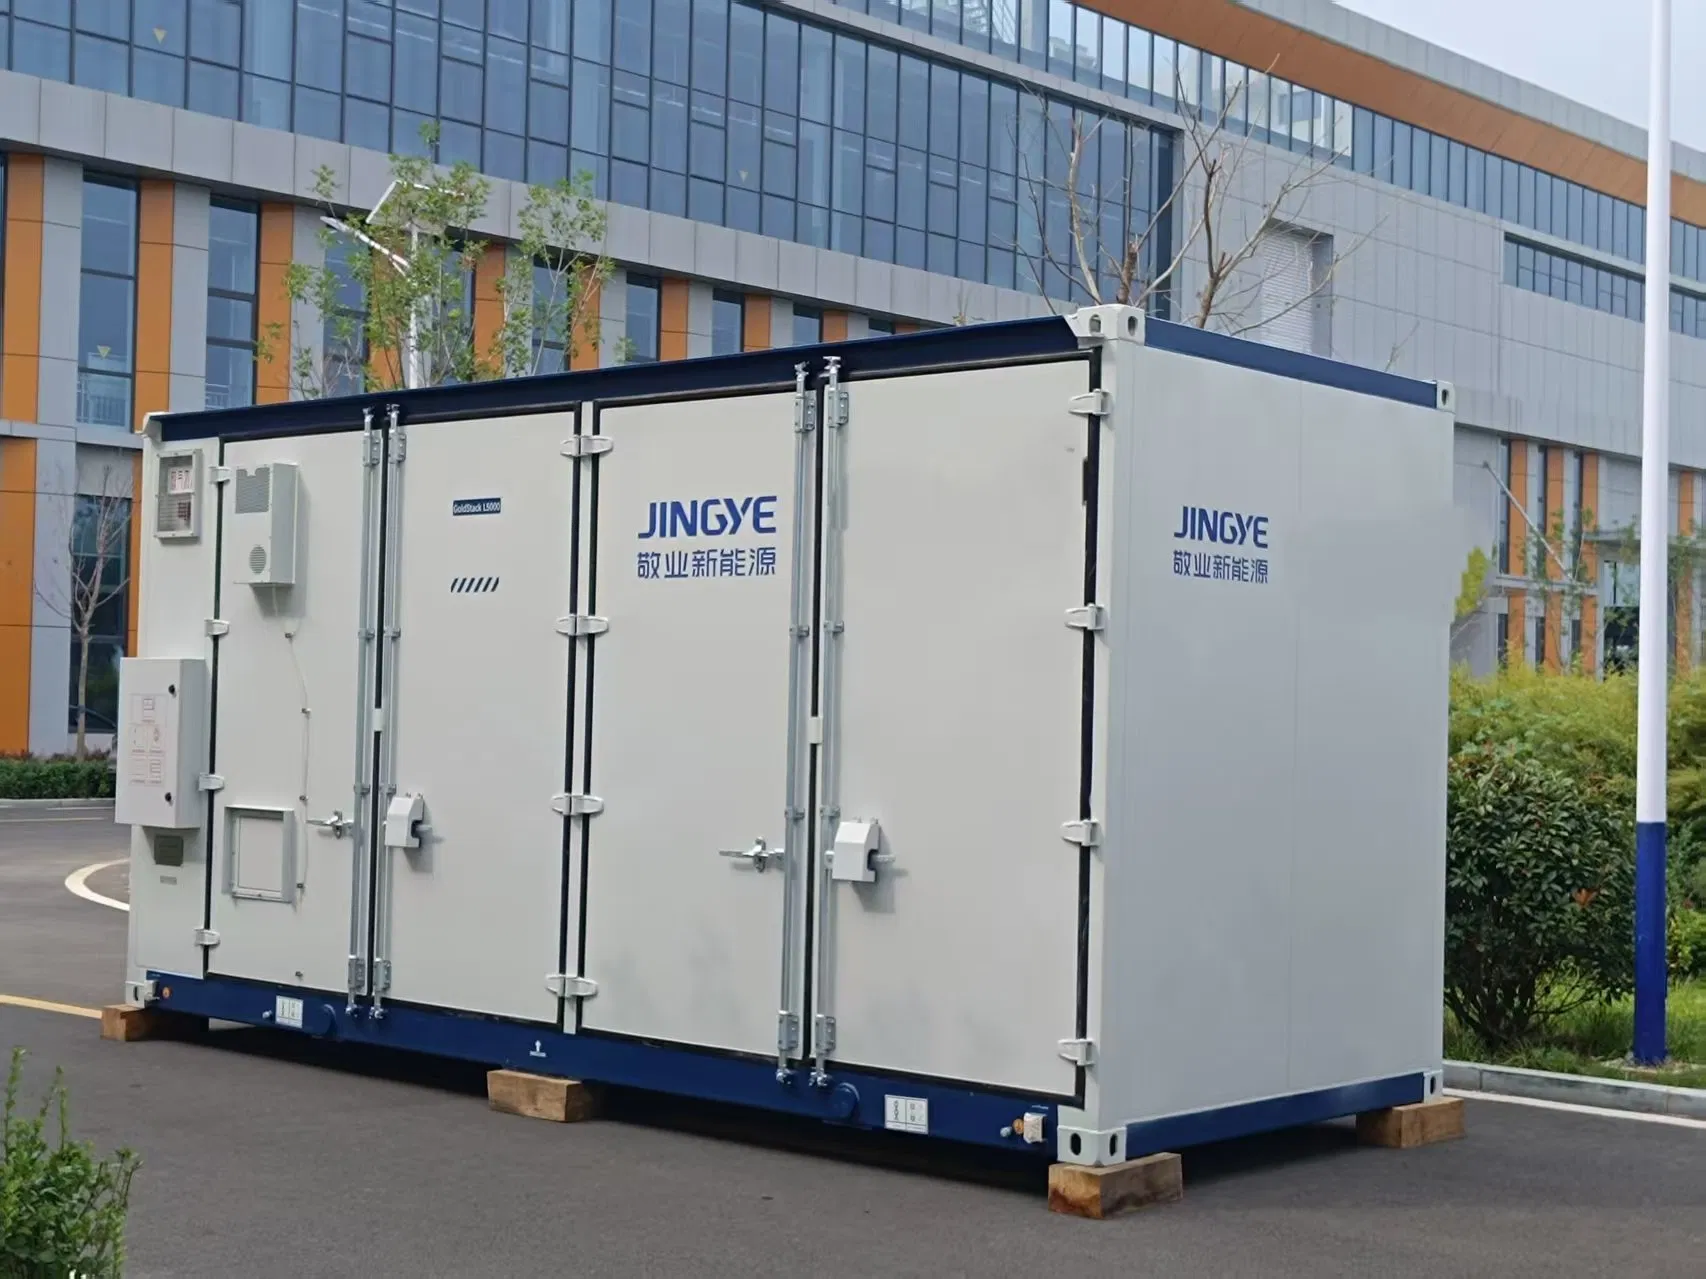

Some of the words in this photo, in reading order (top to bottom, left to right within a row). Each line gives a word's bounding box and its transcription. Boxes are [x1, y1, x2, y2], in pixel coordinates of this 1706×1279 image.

[637, 495, 777, 539] JINGYE
[1173, 505, 1269, 549] JINGYE
[637, 547, 776, 579] 敬业新能源
[1173, 550, 1269, 584] 敬业新能源
